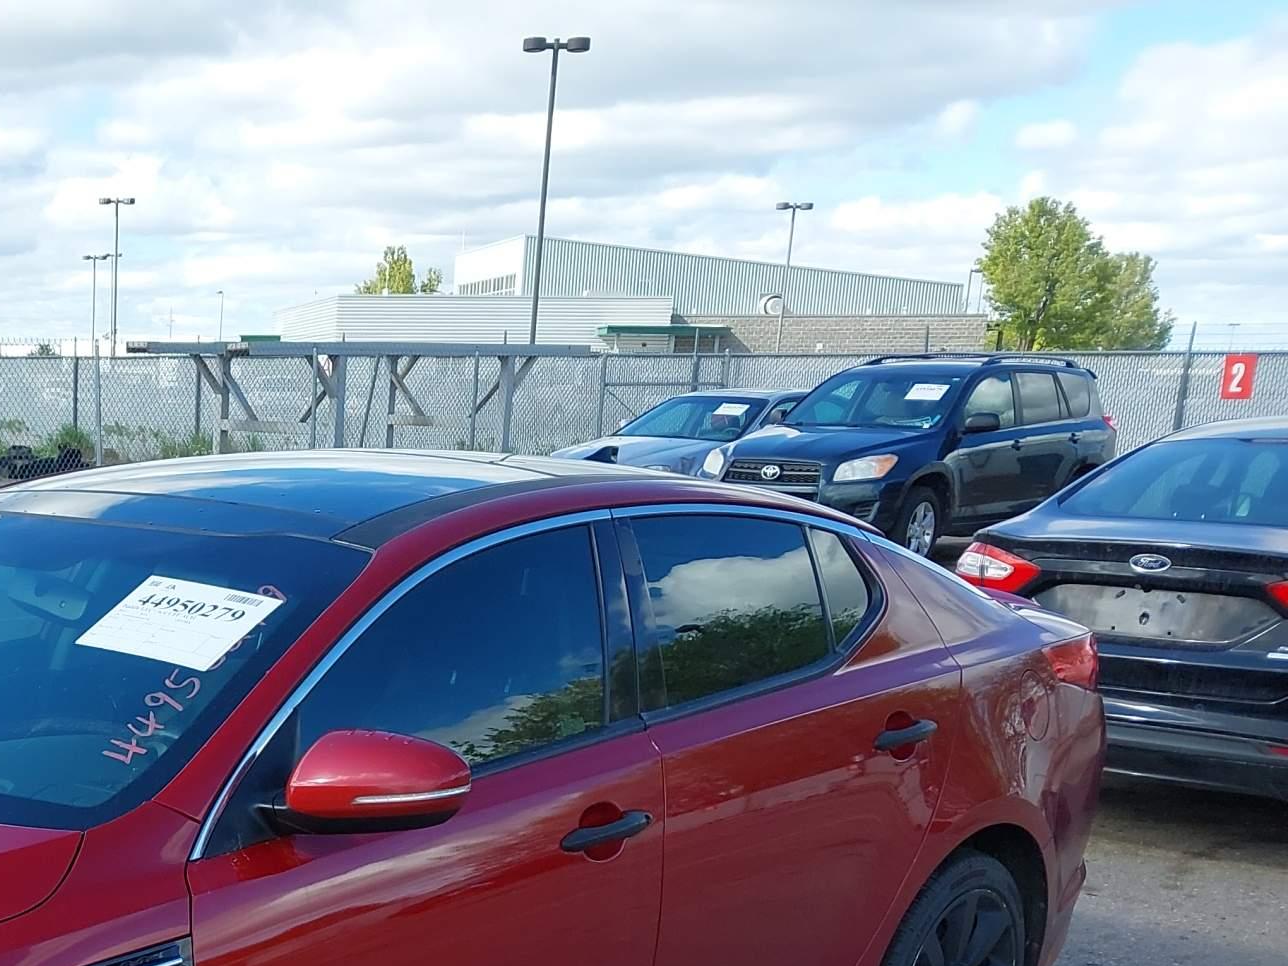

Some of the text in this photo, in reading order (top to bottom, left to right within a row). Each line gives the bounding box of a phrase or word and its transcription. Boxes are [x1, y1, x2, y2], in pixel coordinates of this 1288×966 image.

[1228, 362, 1246, 393] 2
[1138, 557, 1162, 568] Ford
[138, 593, 246, 622] 44950279
